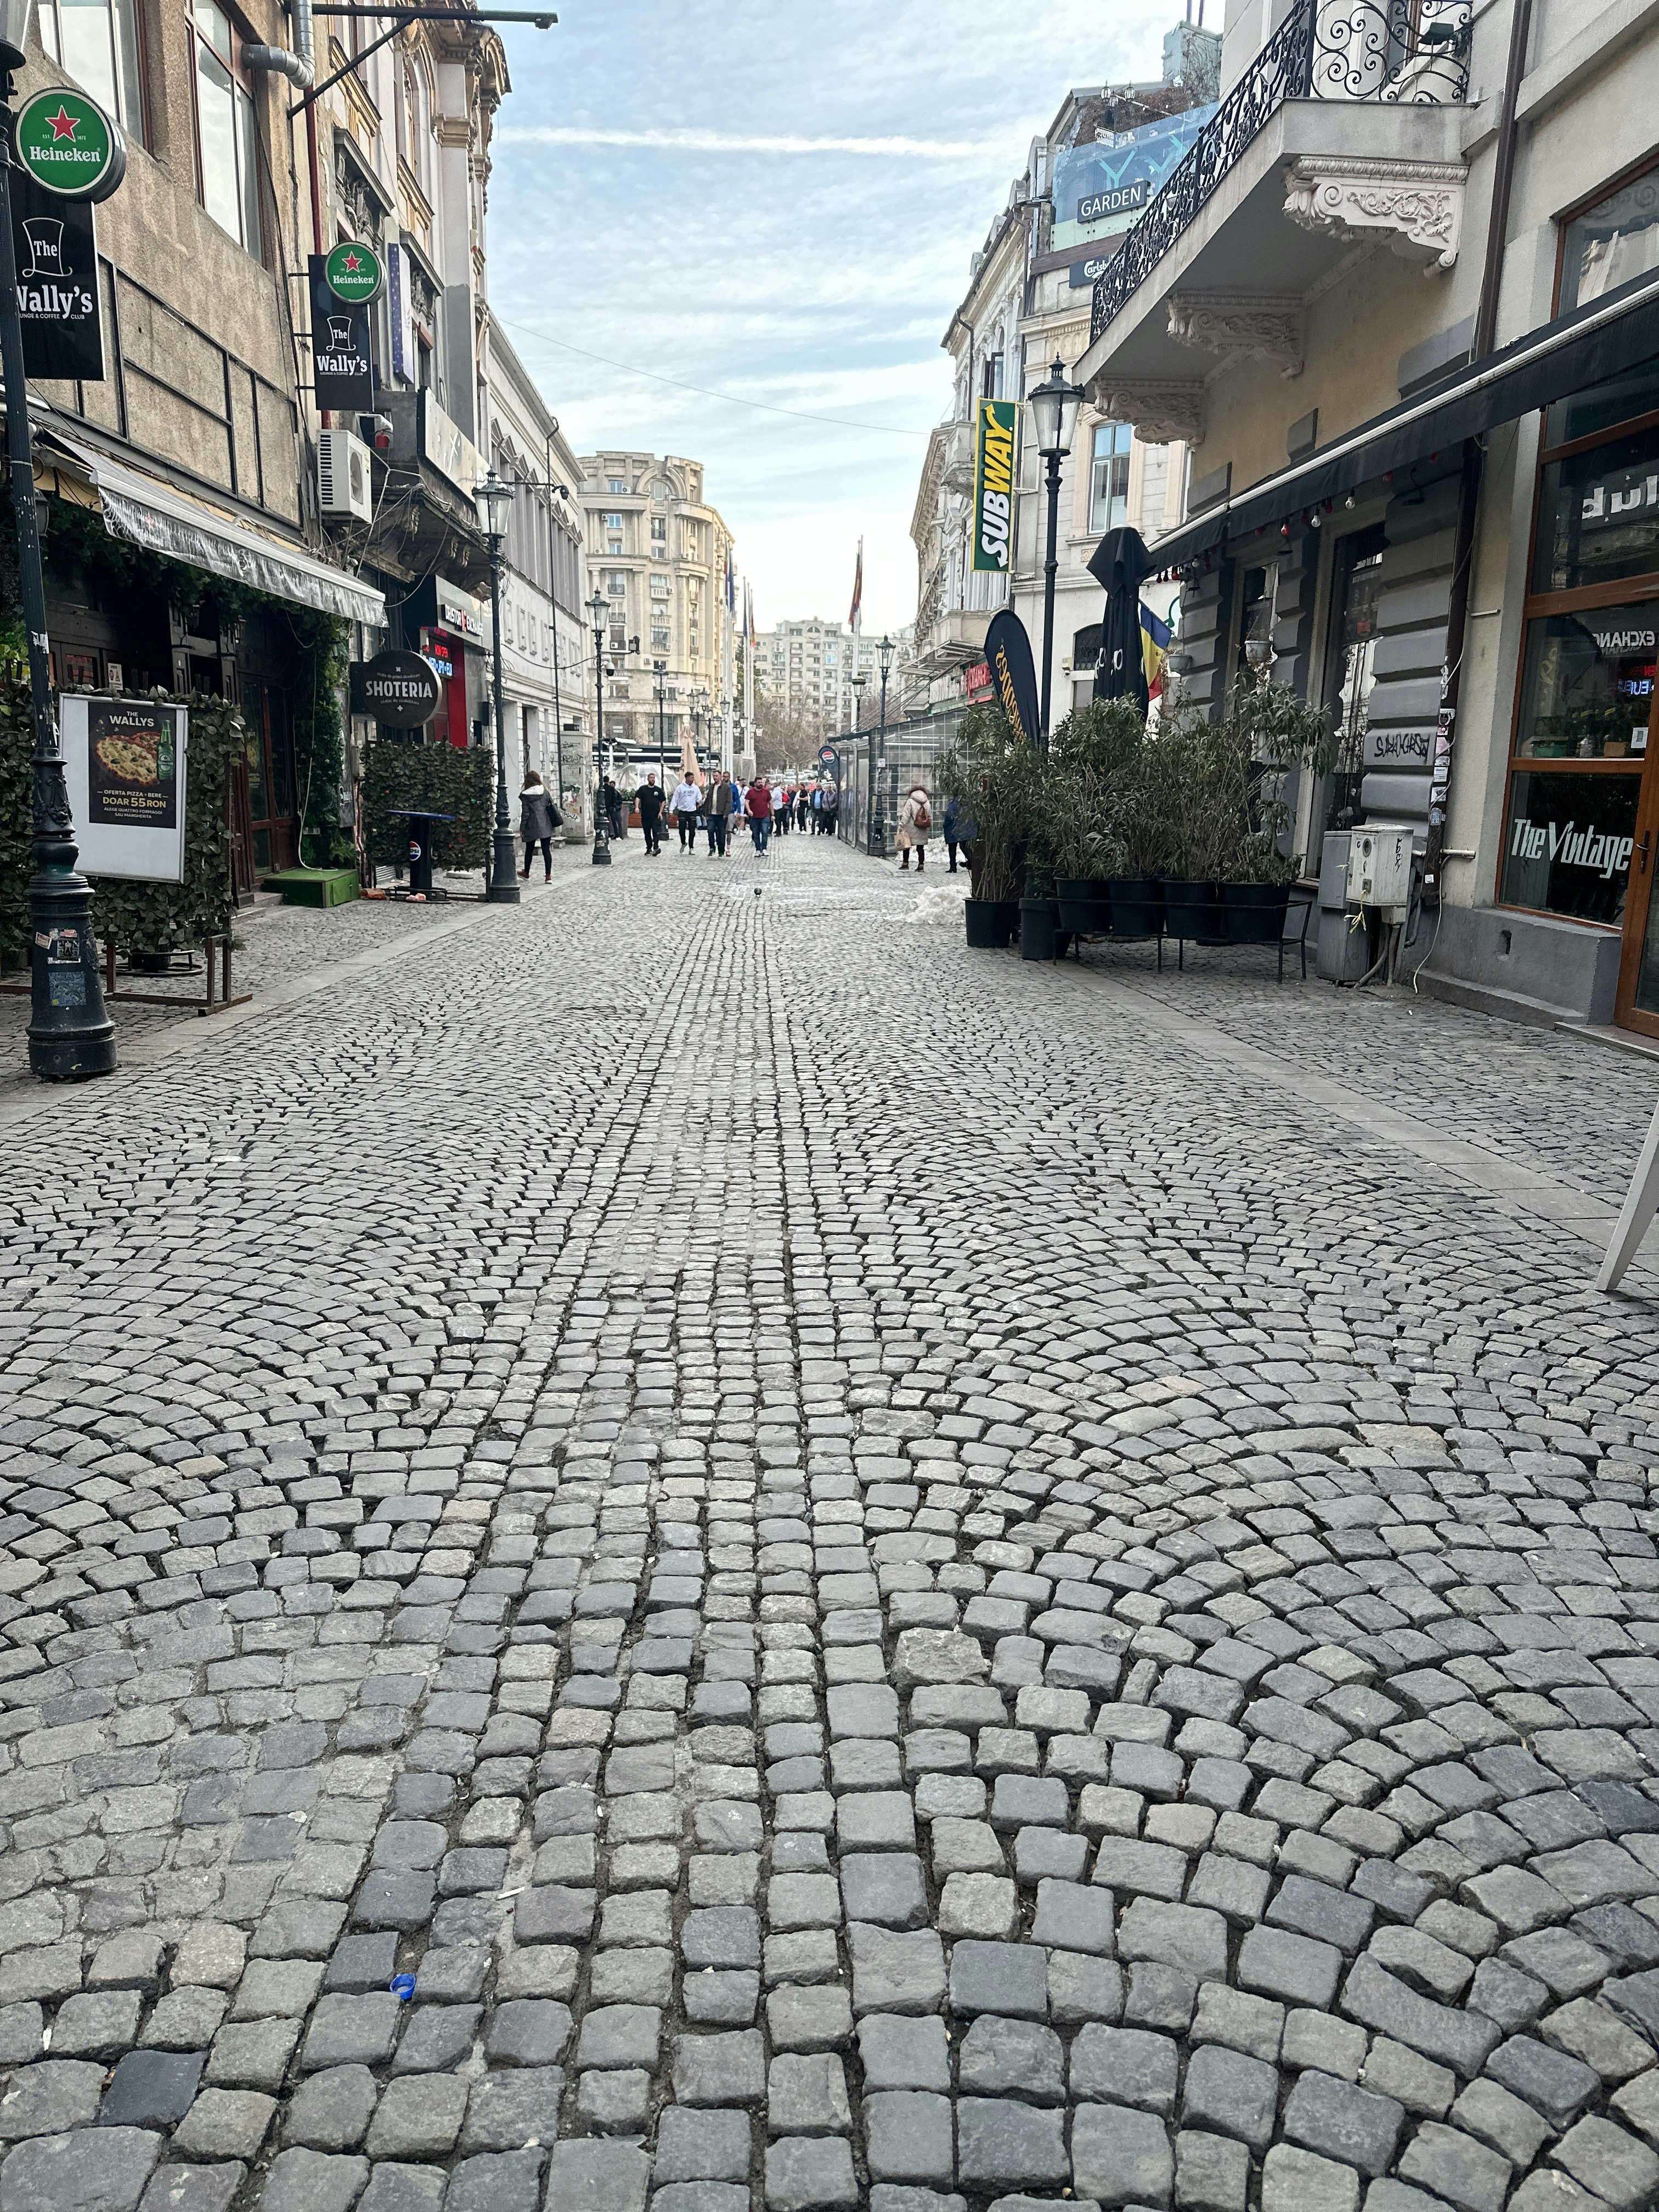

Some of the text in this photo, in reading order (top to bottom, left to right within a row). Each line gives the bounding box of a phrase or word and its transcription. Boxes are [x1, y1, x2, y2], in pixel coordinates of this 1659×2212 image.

[29, 146, 101, 162] Heineken
[1081, 185, 1141, 217] GARDEN
[33, 240, 58, 257] The
[332, 275, 374, 284] Heineken
[333, 329, 347, 339] The
[316, 354, 368, 376] Wally's
[981, 403, 1012, 568] SUBWAY
[365, 680, 433, 698] SHOTERIA
[109, 715, 154, 727] WALLYS
[103, 797, 166, 808] DOAR 55 RON
[1511, 818, 1634, 879] The Vintage
